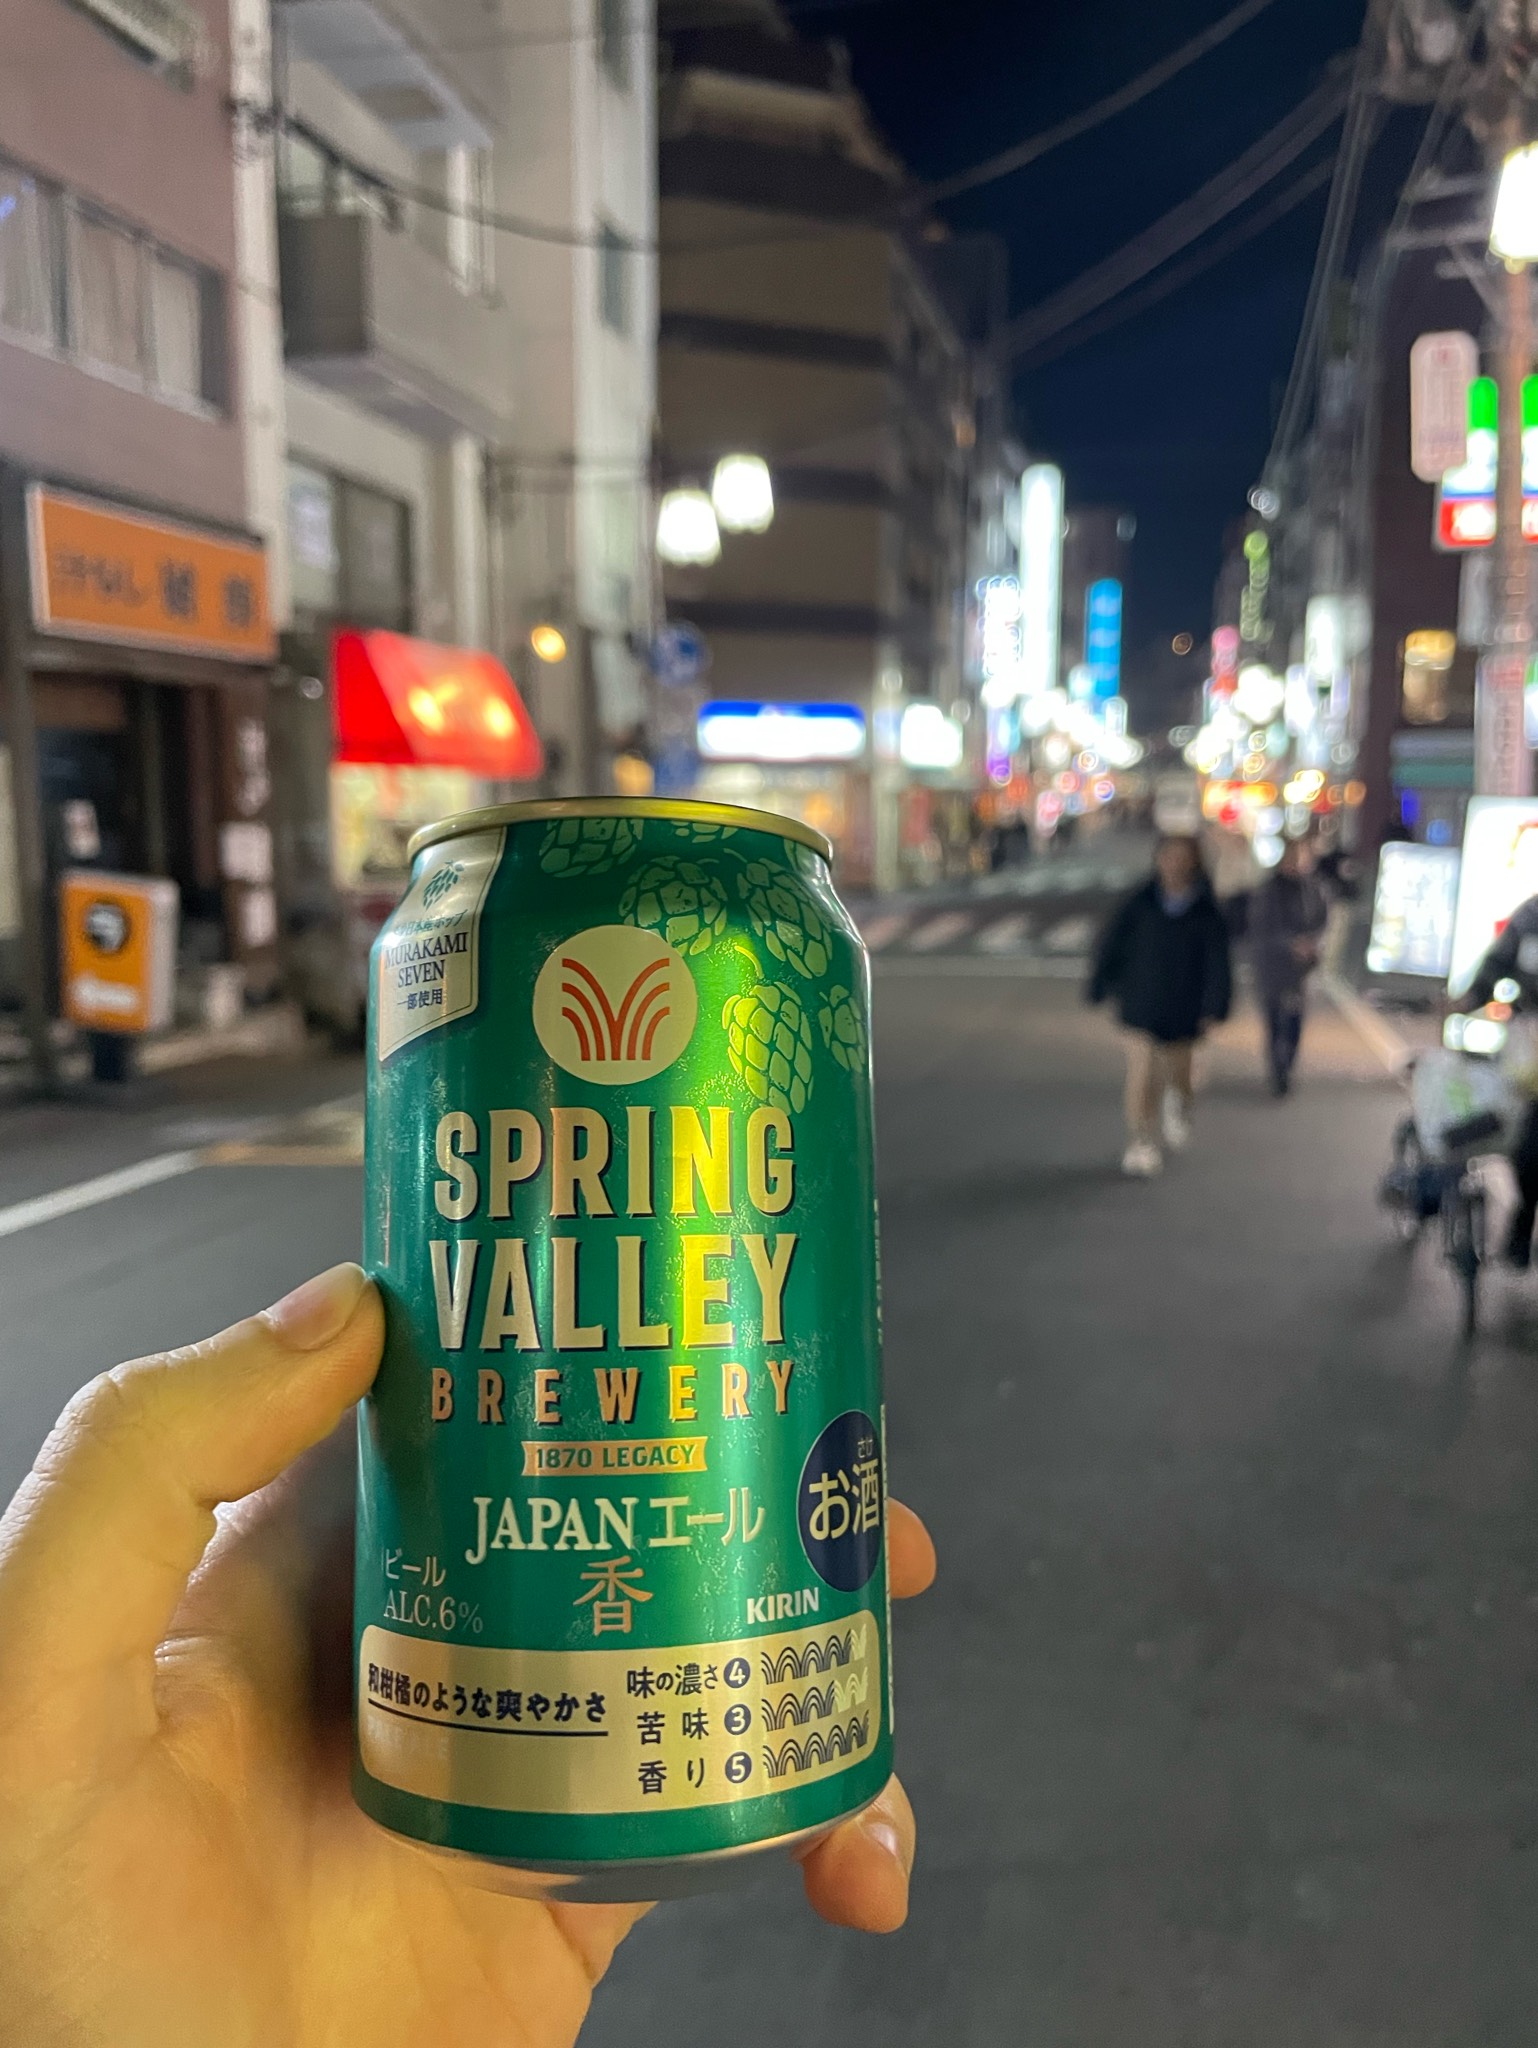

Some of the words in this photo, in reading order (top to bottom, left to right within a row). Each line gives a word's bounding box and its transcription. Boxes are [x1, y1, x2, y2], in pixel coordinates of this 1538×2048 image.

[384, 931, 469, 968] MURAKAMI
[397, 959, 446, 989] SEVEN
[397, 988, 443, 1010] 一部使用
[434, 1106, 796, 1222] SPRING
[428, 1233, 798, 1352] VALLEY
[431, 1359, 794, 1425] BREWERY
[536, 1447, 593, 1469] 1870
[602, 1443, 697, 1468] LEGACY
[808, 1457, 881, 1541] お酒
[465, 1496, 640, 1566] JAPAN
[385, 1547, 447, 1588] ビール
[383, 1588, 484, 1634] ALC.6%
[572, 1554, 654, 1637] 香
[746, 1586, 820, 1625] KIRIN
[368, 1662, 607, 1724] 和柑橘のような爽やかさ
[626, 1662, 719, 1700] 味の濃さ
